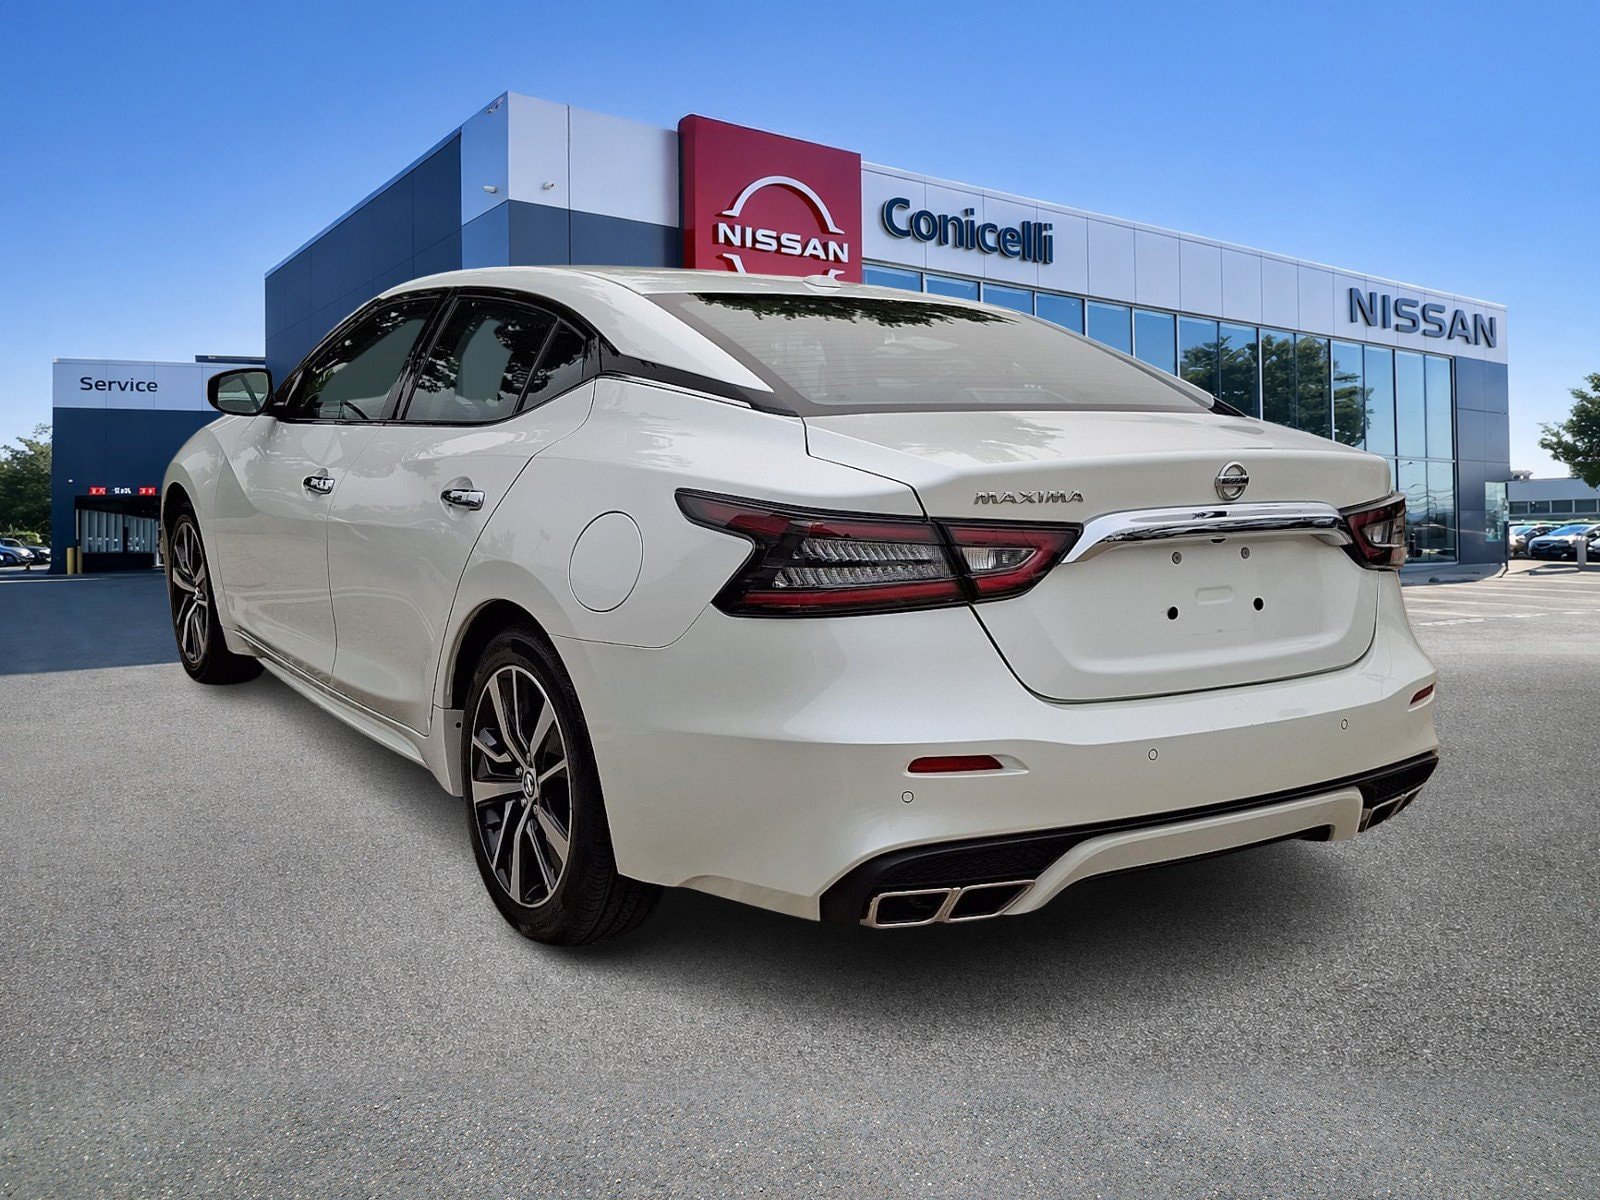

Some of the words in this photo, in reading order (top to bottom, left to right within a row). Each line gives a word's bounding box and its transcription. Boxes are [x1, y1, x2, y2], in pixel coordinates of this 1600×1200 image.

[717, 222, 849, 263] NISSAN
[881, 197, 1054, 264] Conicelli
[1349, 287, 1497, 348] NISSAN
[80, 376, 158, 392] Service
[973, 490, 1084, 505] MAXIMA
